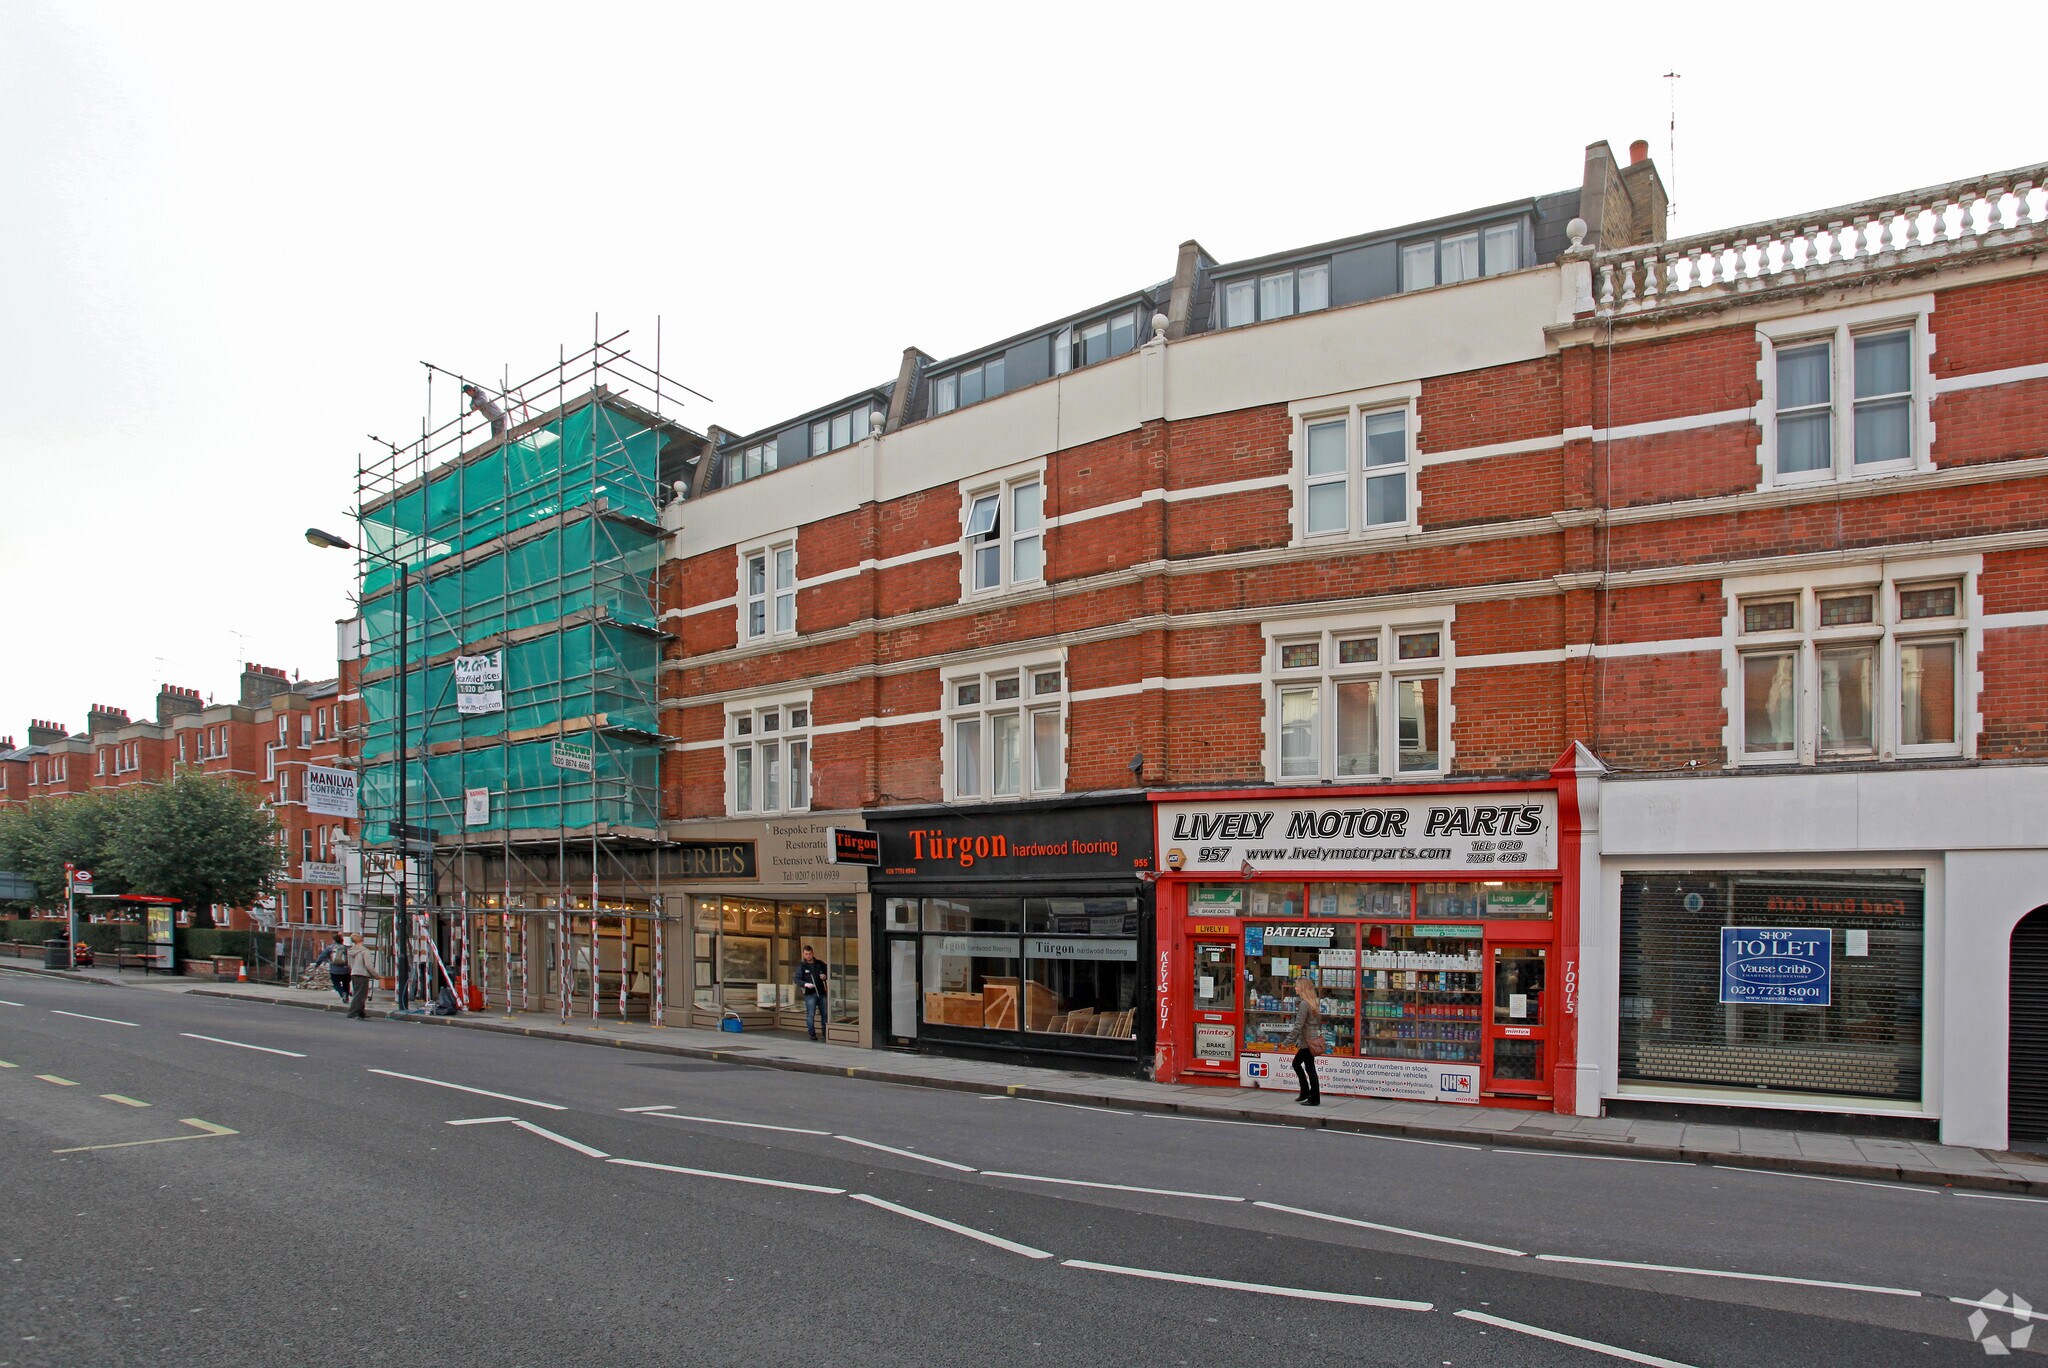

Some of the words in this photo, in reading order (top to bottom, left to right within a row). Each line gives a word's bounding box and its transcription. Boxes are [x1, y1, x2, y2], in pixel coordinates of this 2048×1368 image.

[310, 772, 354, 788] MANILVA
[310, 784, 354, 797] CONTRACTS
[1172, 811, 1274, 840] LIVELY
[1285, 808, 1409, 839] MOTOR
[1424, 804, 1544, 837] PARTS
[773, 824, 808, 836] Bespoke
[786, 838, 828, 850] Restoratio
[836, 833, 877, 852] Türgon
[909, 830, 1007, 866] Türgon
[1012, 841, 1068, 856] hardwood
[1072, 840, 1118, 856] flooring
[1470, 840, 1495, 851] TEL:
[1497, 840, 1524, 850] 020
[1198, 846, 1232, 862] 957
[1466, 853, 1494, 864] 7736
[626, 846, 745, 876] GALLERIES
[772, 856, 812, 866] Extensive
[1134, 859, 1148, 867] 955
[794, 871, 810, 880] 0207
[811, 871, 823, 880] 610
[824, 870, 840, 880] 6939
[1264, 926, 1334, 937] BATTERIES
[1759, 931, 1792, 940] SHOP
[938, 940, 966, 953] ürgon
[1036, 942, 1074, 957] Türgon
[1076, 945, 1104, 955] hardwood
[1105, 947, 1127, 956] flooring
[1732, 940, 1766, 955] TO
[1771, 941, 1820, 956] LET
[1160, 951, 1168, 992] KEYS
[1740, 964, 1776, 973] Vause
[1778, 965, 1811, 974] Cribb
[1565, 961, 1576, 1014] TOOLS
[1730, 986, 1755, 994] 020
[1758, 986, 1785, 995] 7731
[1788, 988, 1819, 996] 8001
